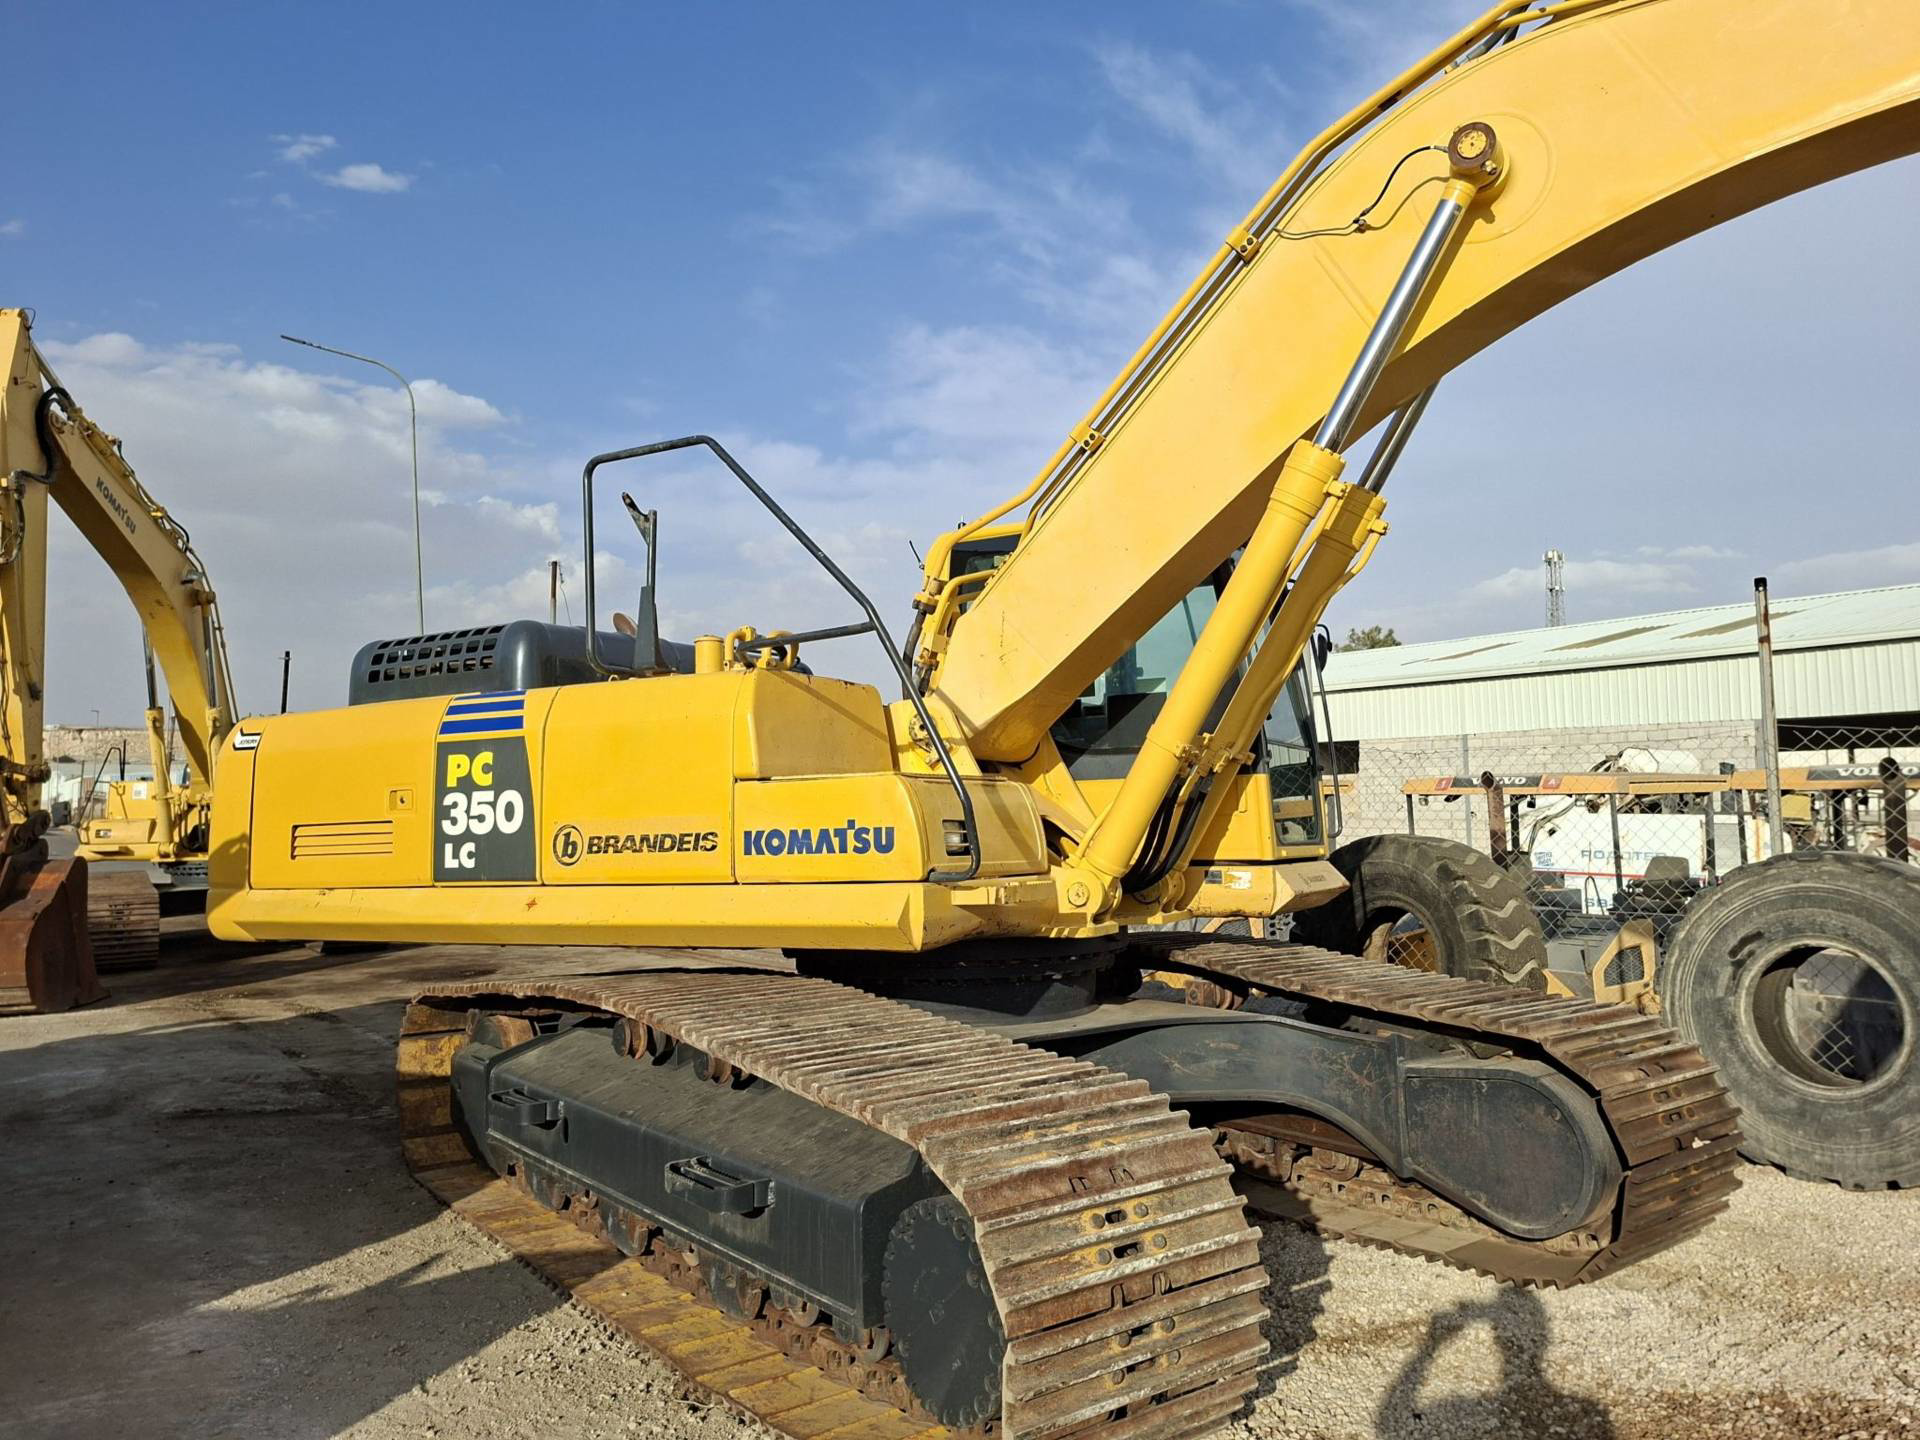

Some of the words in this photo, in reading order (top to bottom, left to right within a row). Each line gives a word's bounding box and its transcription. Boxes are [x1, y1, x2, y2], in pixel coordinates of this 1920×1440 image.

[96, 476, 136, 534] KOMATSU
[447, 751, 493, 788] PC
[1471, 776, 1527, 785] VLVO
[1836, 766, 1919, 776] VOLO
[441, 790, 524, 836] 350
[586, 831, 719, 854] BRANDEIS
[743, 819, 895, 856] KOMATSU
[444, 842, 476, 869] LC
